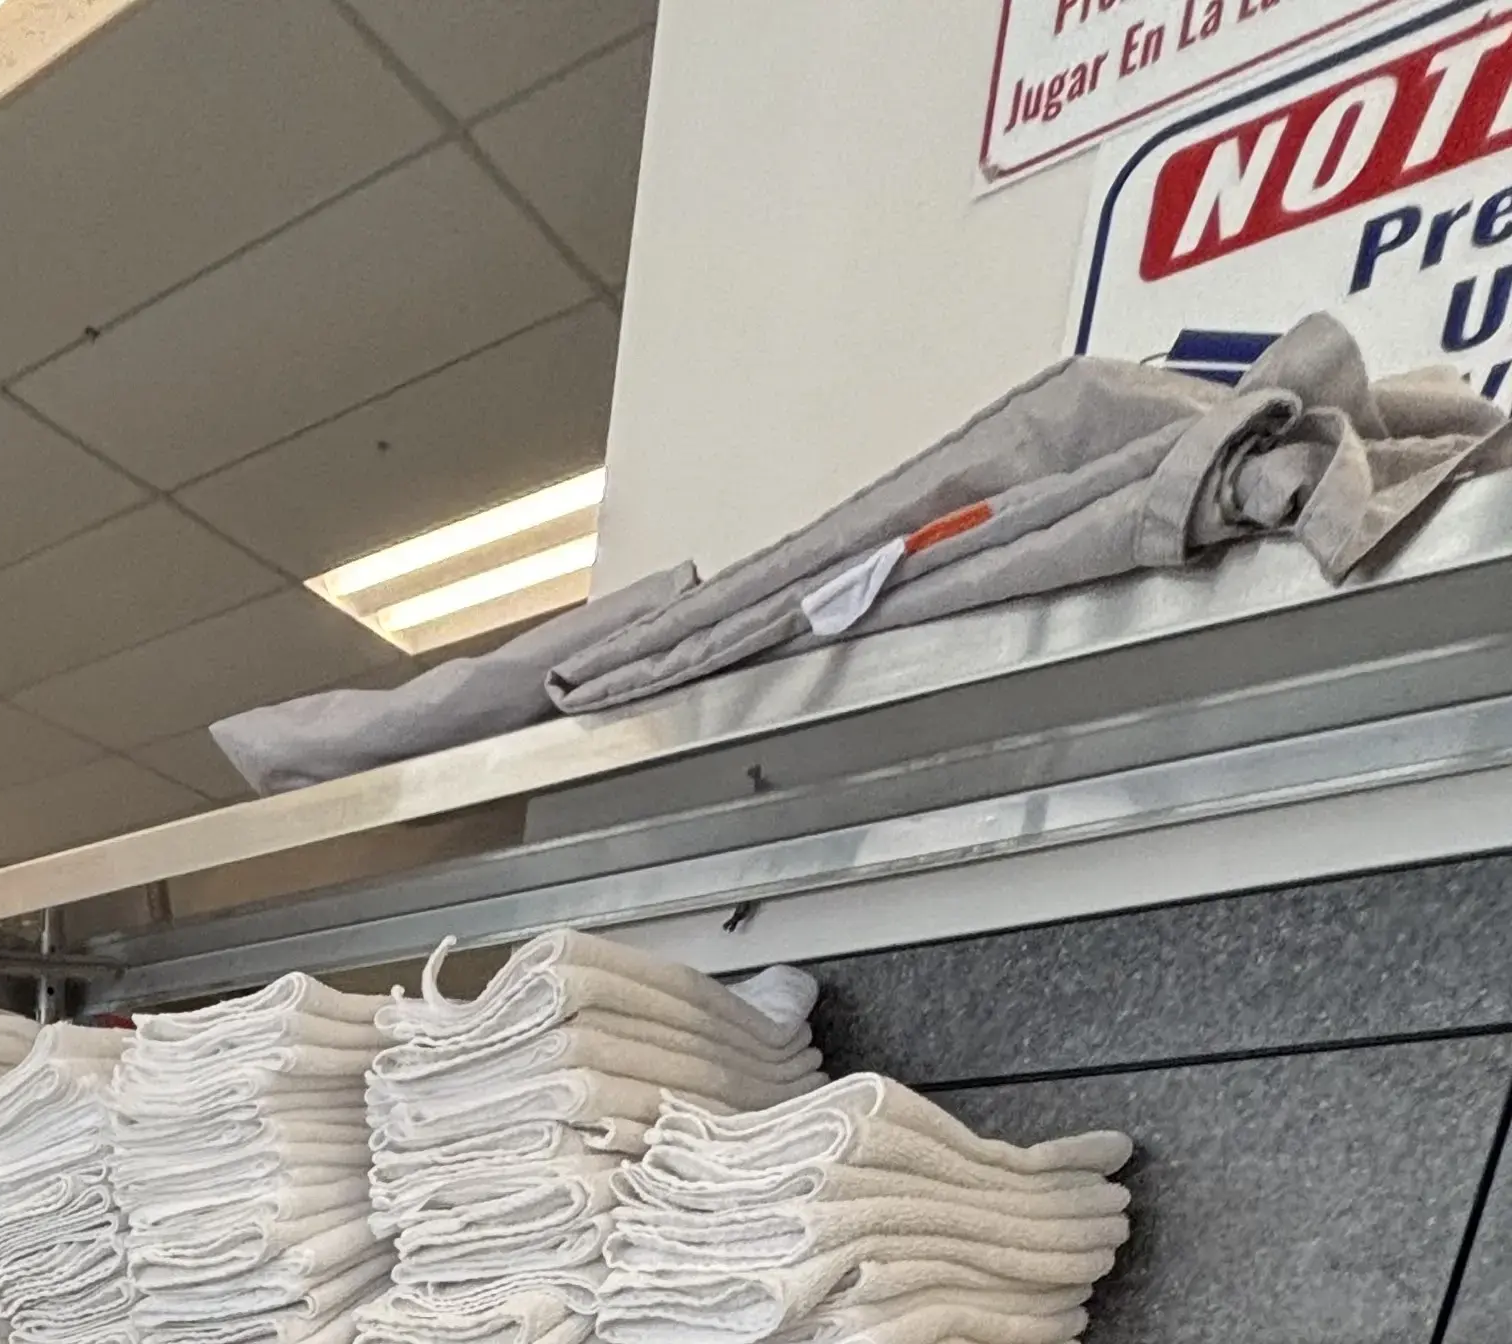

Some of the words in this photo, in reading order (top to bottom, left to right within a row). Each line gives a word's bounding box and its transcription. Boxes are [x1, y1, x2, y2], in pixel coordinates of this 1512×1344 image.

[1004, 52, 1108, 135] Jugar
[1119, 20, 1165, 78] En
[1178, 0, 1224, 50] La
